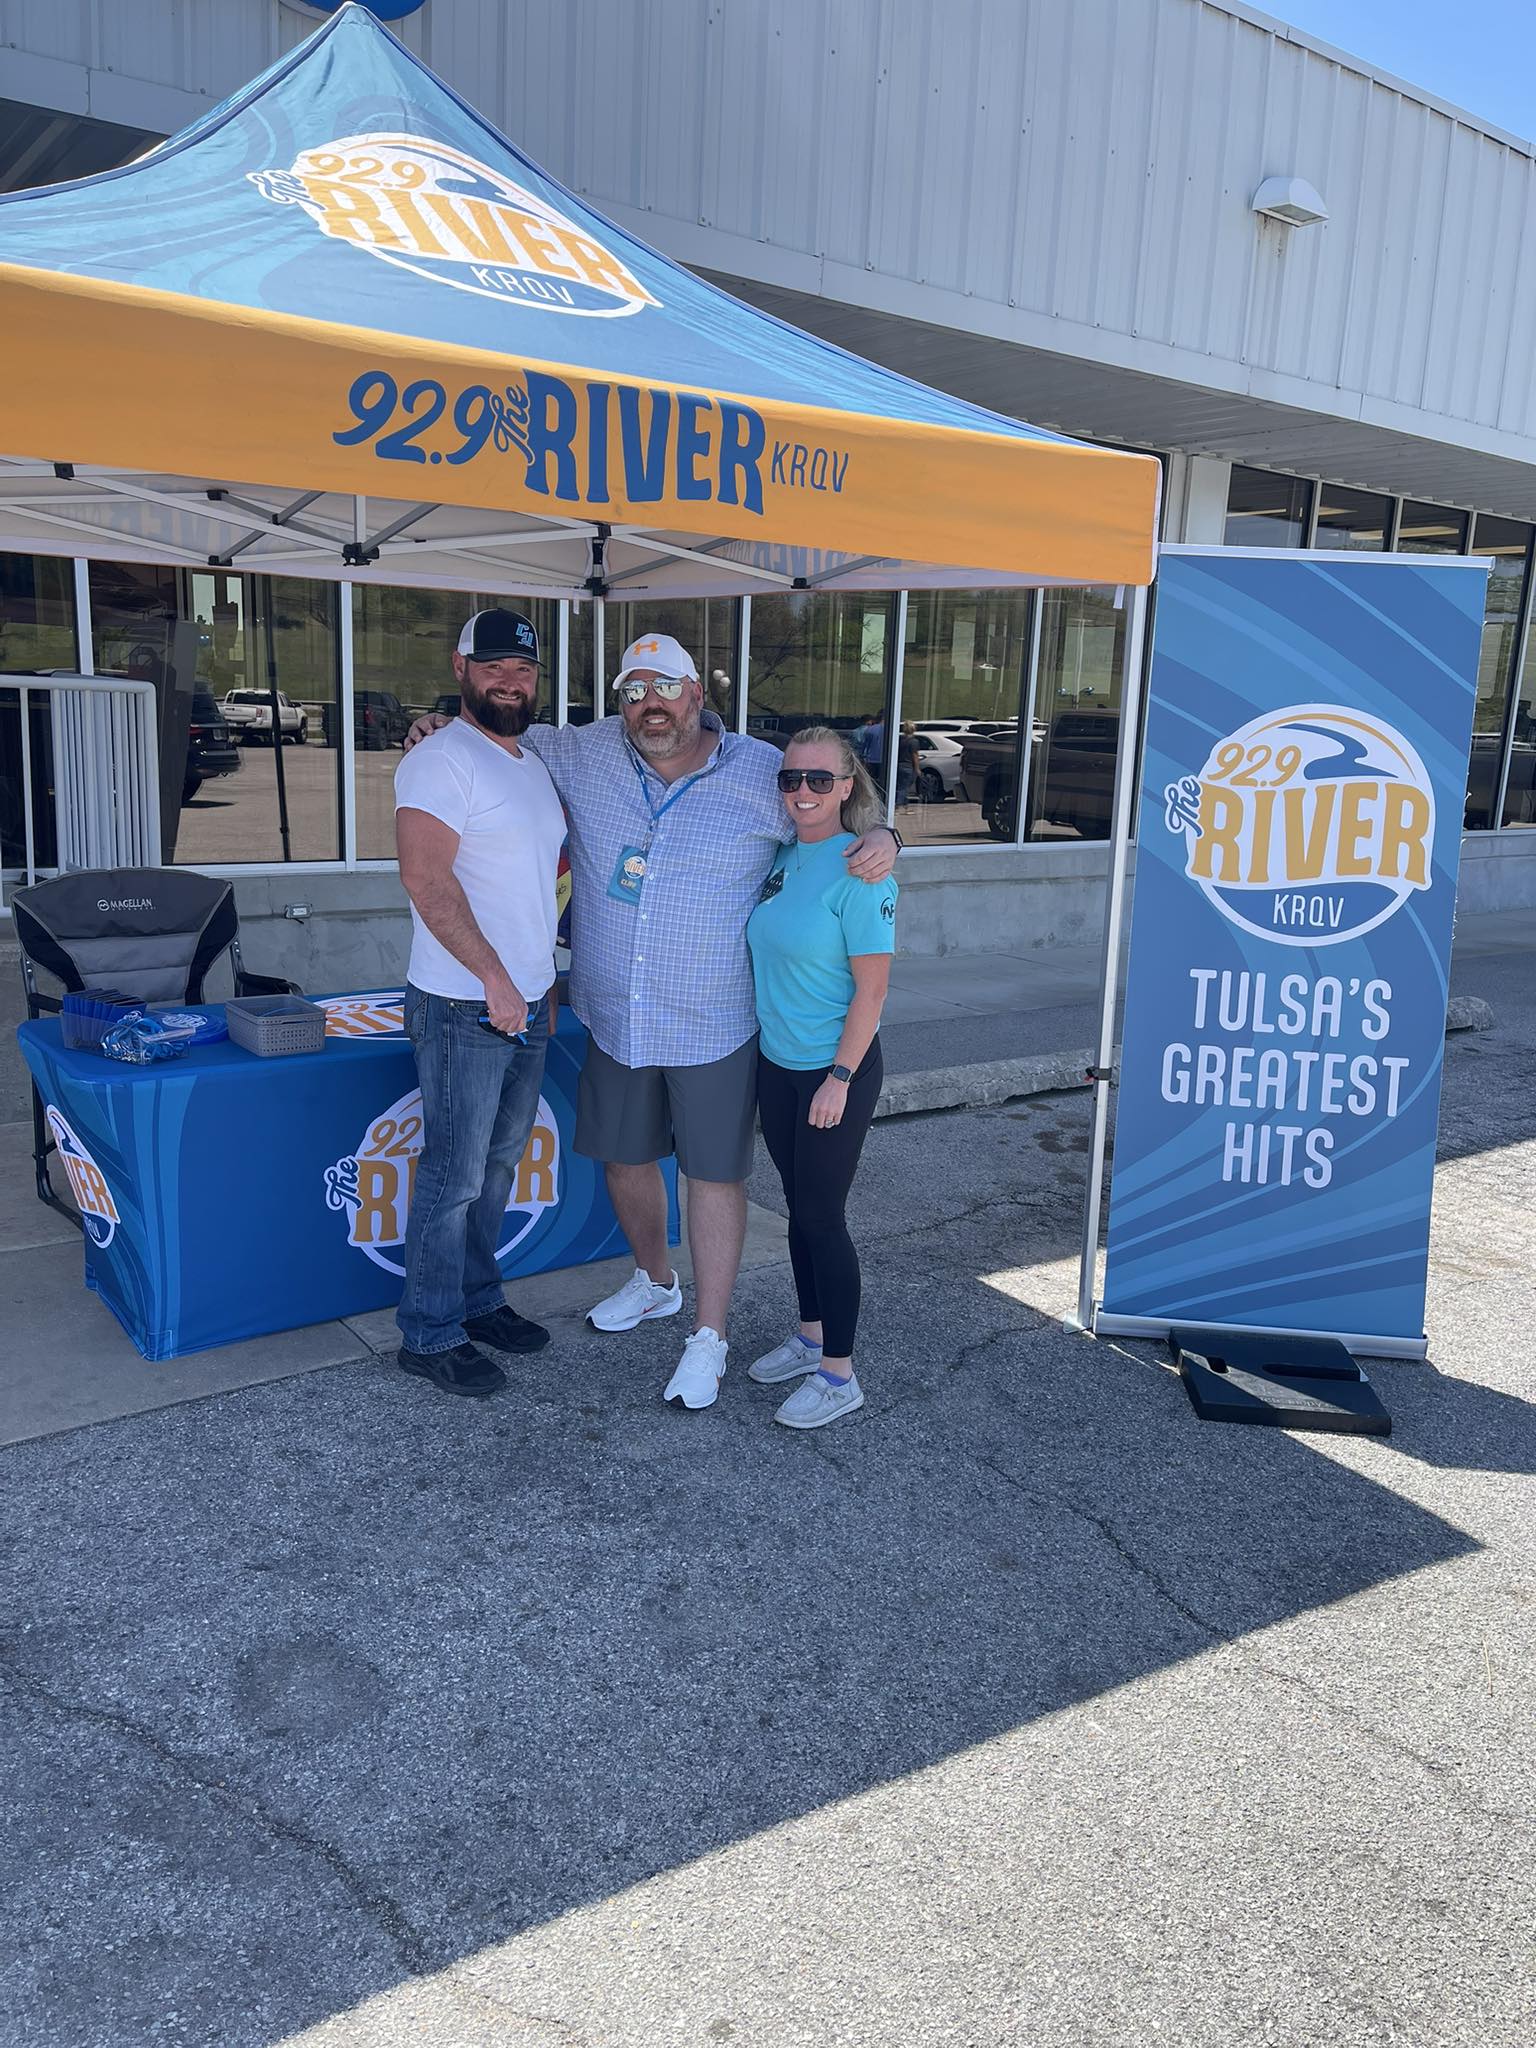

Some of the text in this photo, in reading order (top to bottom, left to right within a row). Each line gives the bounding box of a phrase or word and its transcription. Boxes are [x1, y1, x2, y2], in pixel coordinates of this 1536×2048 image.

[304, 153, 427, 190] 92.9
[247, 170, 656, 305] The RIVER
[470, 265, 574, 305] KRQV
[332, 368, 849, 516] 92.9 The RIVER KRQV
[1207, 742, 1302, 787] 92.9
[1167, 777, 1431, 885] The RIVER
[110, 898, 153, 909] MAGELLAN
[1272, 893, 1345, 928] KRQV
[1189, 968, 1393, 1041] TULSA'S
[1160, 1042, 1410, 1118] GREATEST
[363, 1116, 425, 1158] 92.
[1221, 1121, 1335, 1189] HITS
[327, 1159, 363, 1209] The
